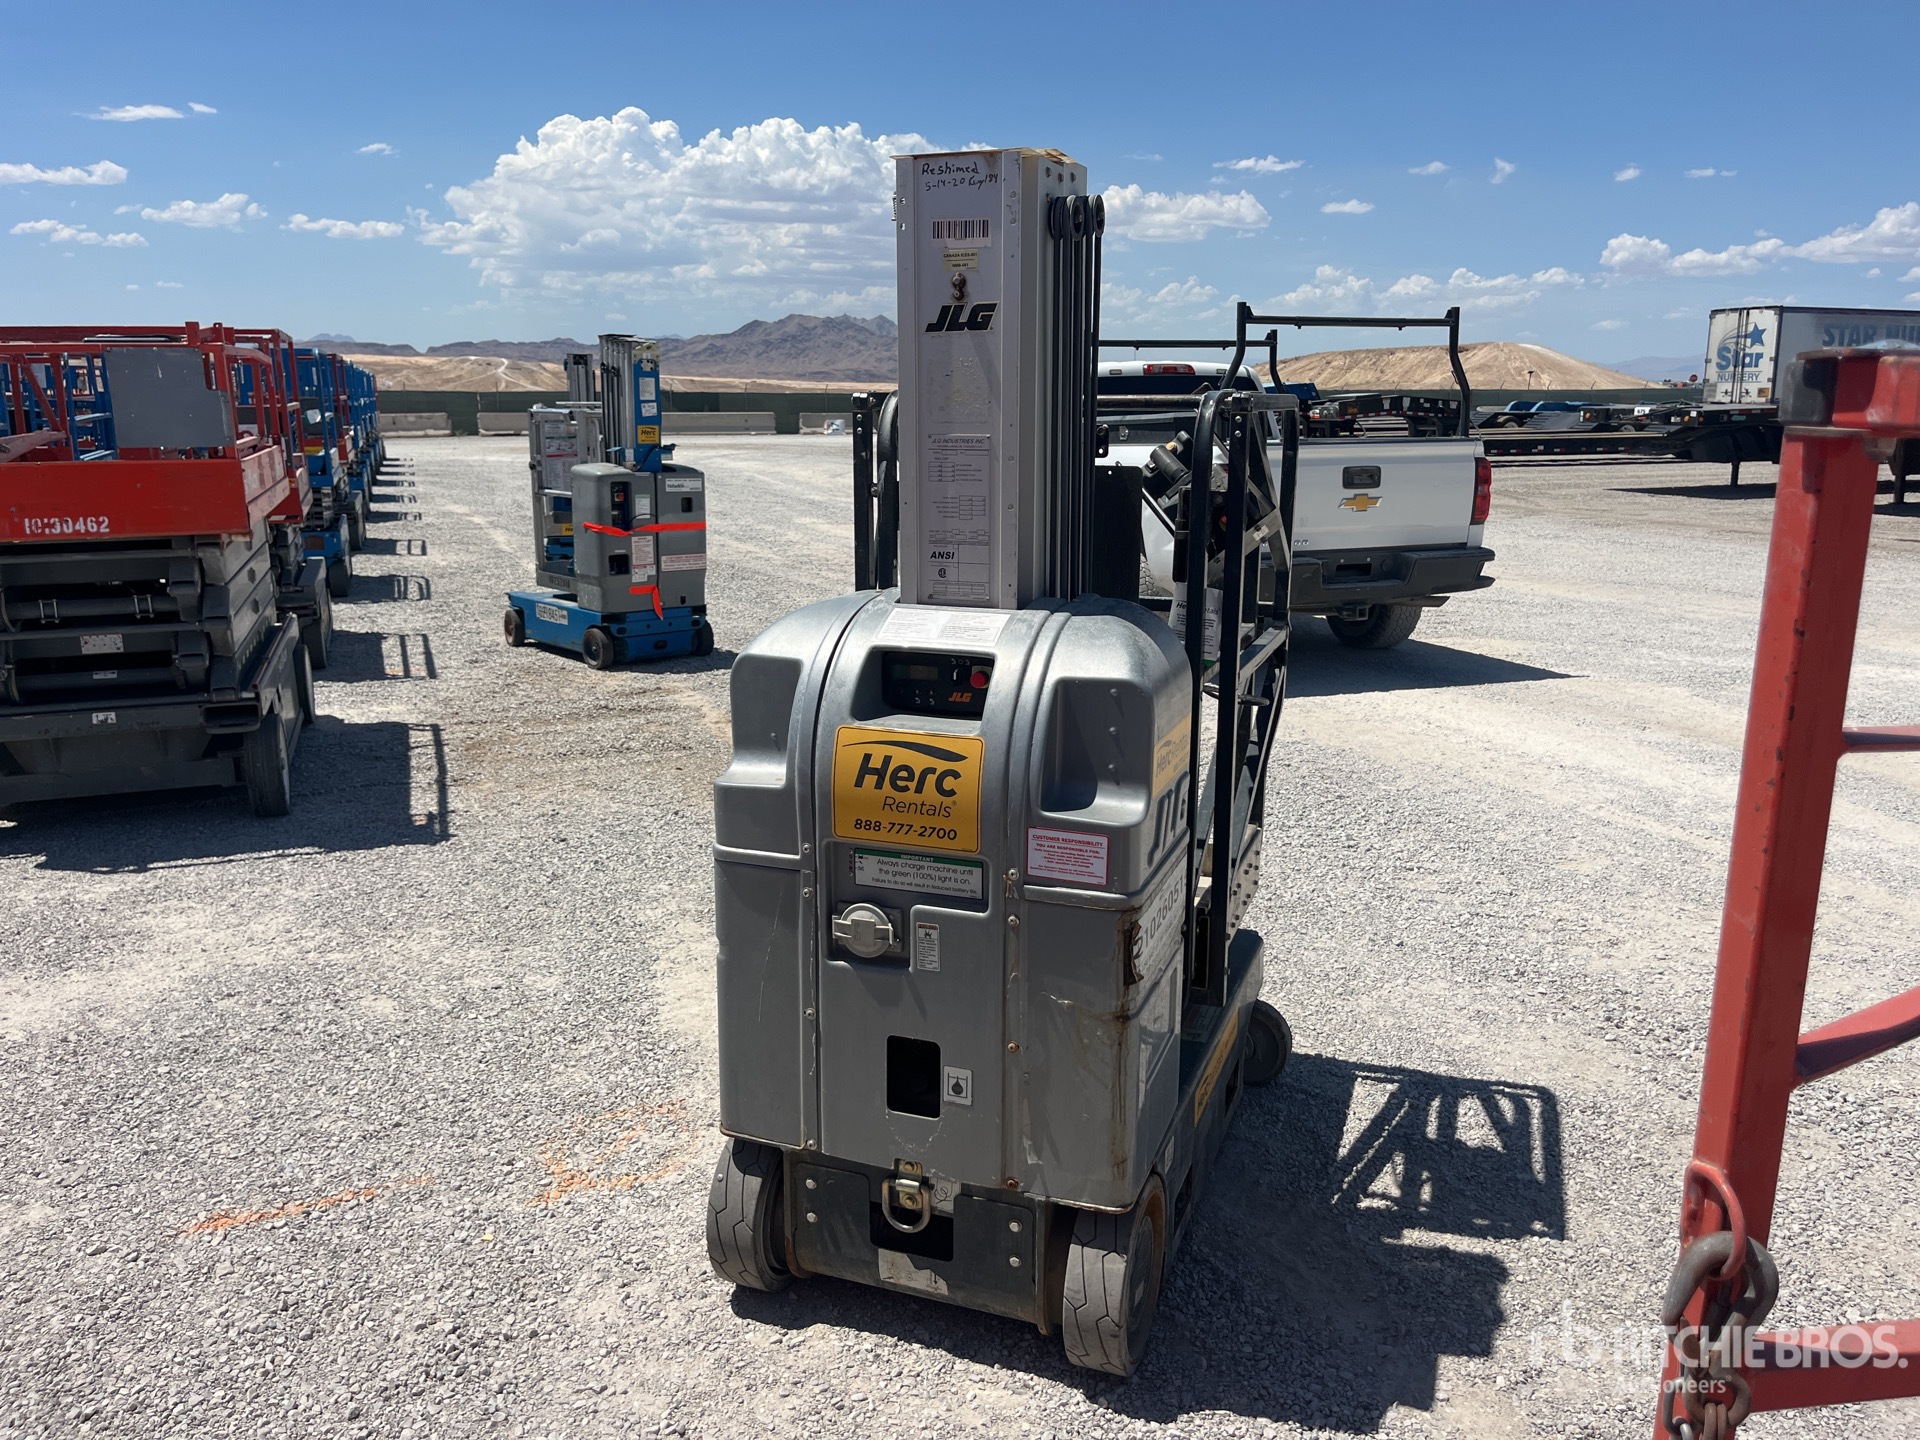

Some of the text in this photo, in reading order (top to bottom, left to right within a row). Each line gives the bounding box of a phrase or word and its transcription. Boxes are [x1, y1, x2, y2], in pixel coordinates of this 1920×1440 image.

[924, 302, 998, 333] JLG
[1822, 323, 1877, 347] STAR
[1716, 346, 1763, 370] Star
[930, 551, 955, 560] ANSI
[948, 692, 972, 703] JLG
[854, 753, 961, 798] Herc
[854, 818, 958, 842] 888-777-2700
[1032, 834, 1104, 847] CUSTOMER RESPONSIBILITY
[1057, 845, 1087, 853] RESPONSIBLE
[900, 854, 934, 863] IMPORTANT
[877, 858, 899, 868] Always
[901, 862, 925, 871] charge
[927, 864, 958, 874] machine
[891, 870, 911, 878] green
[912, 872, 936, 881] (100%)
[938, 875, 952, 883] light
